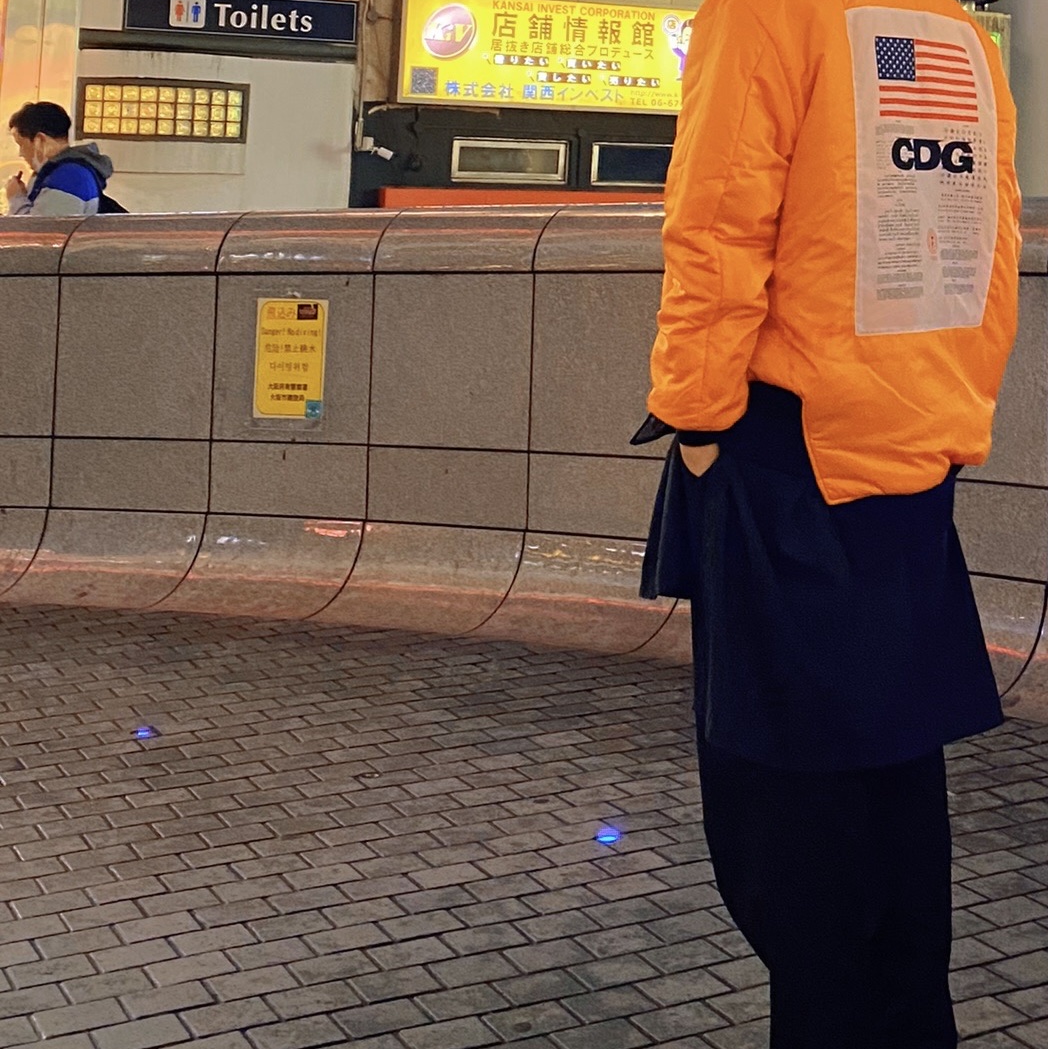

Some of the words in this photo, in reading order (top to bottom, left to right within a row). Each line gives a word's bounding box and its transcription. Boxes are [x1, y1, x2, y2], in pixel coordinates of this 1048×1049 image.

[214, 2, 313, 33] Toilets
[492, 0, 534, 12] KANSAI
[537, 3, 576, 15] INVEST
[580, 6, 656, 21] CORPORATION
[492, 11, 655, 47] 店舗情報館
[892, 137, 974, 174] CDG
